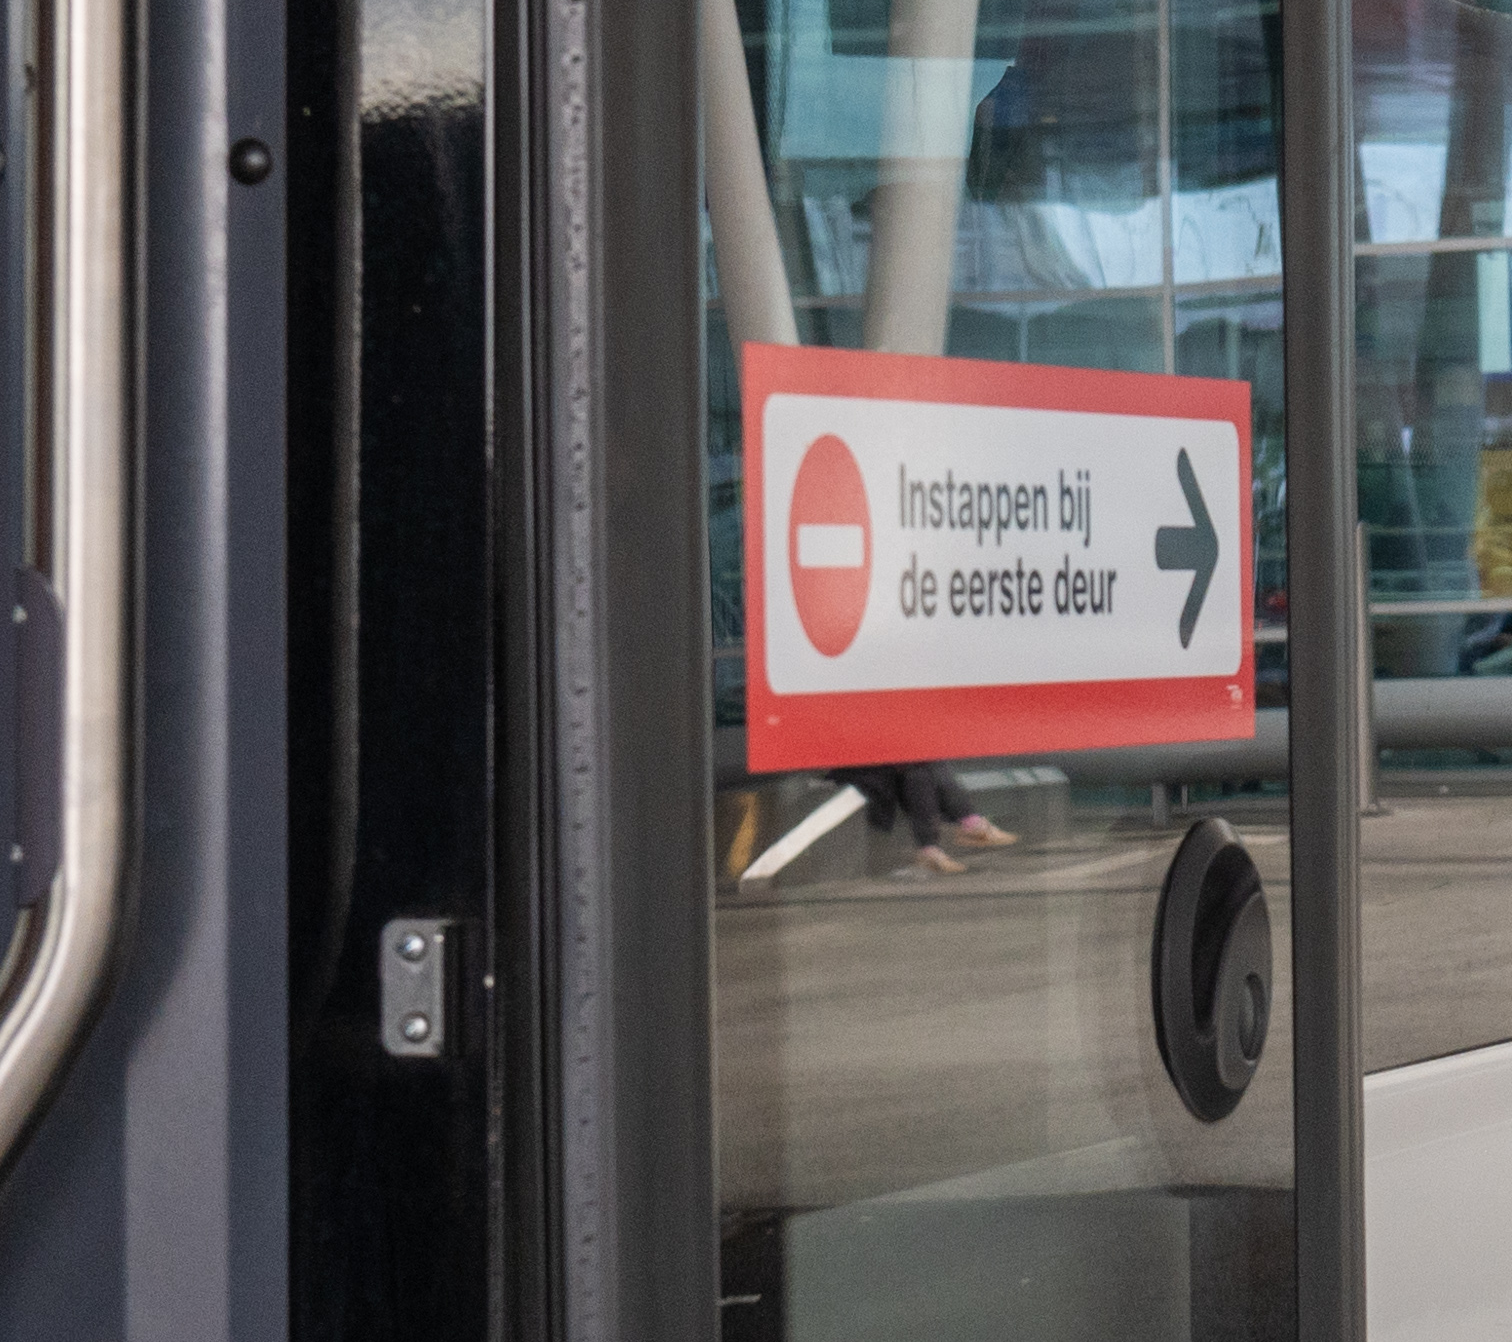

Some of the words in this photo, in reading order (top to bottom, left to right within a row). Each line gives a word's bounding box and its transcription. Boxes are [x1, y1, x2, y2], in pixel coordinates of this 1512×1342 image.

[899, 461, 1049, 547] Instappen
[1058, 467, 1092, 548] bij
[899, 551, 937, 618] de
[949, 556, 1044, 618] eerste
[1054, 552, 1117, 616] deur
